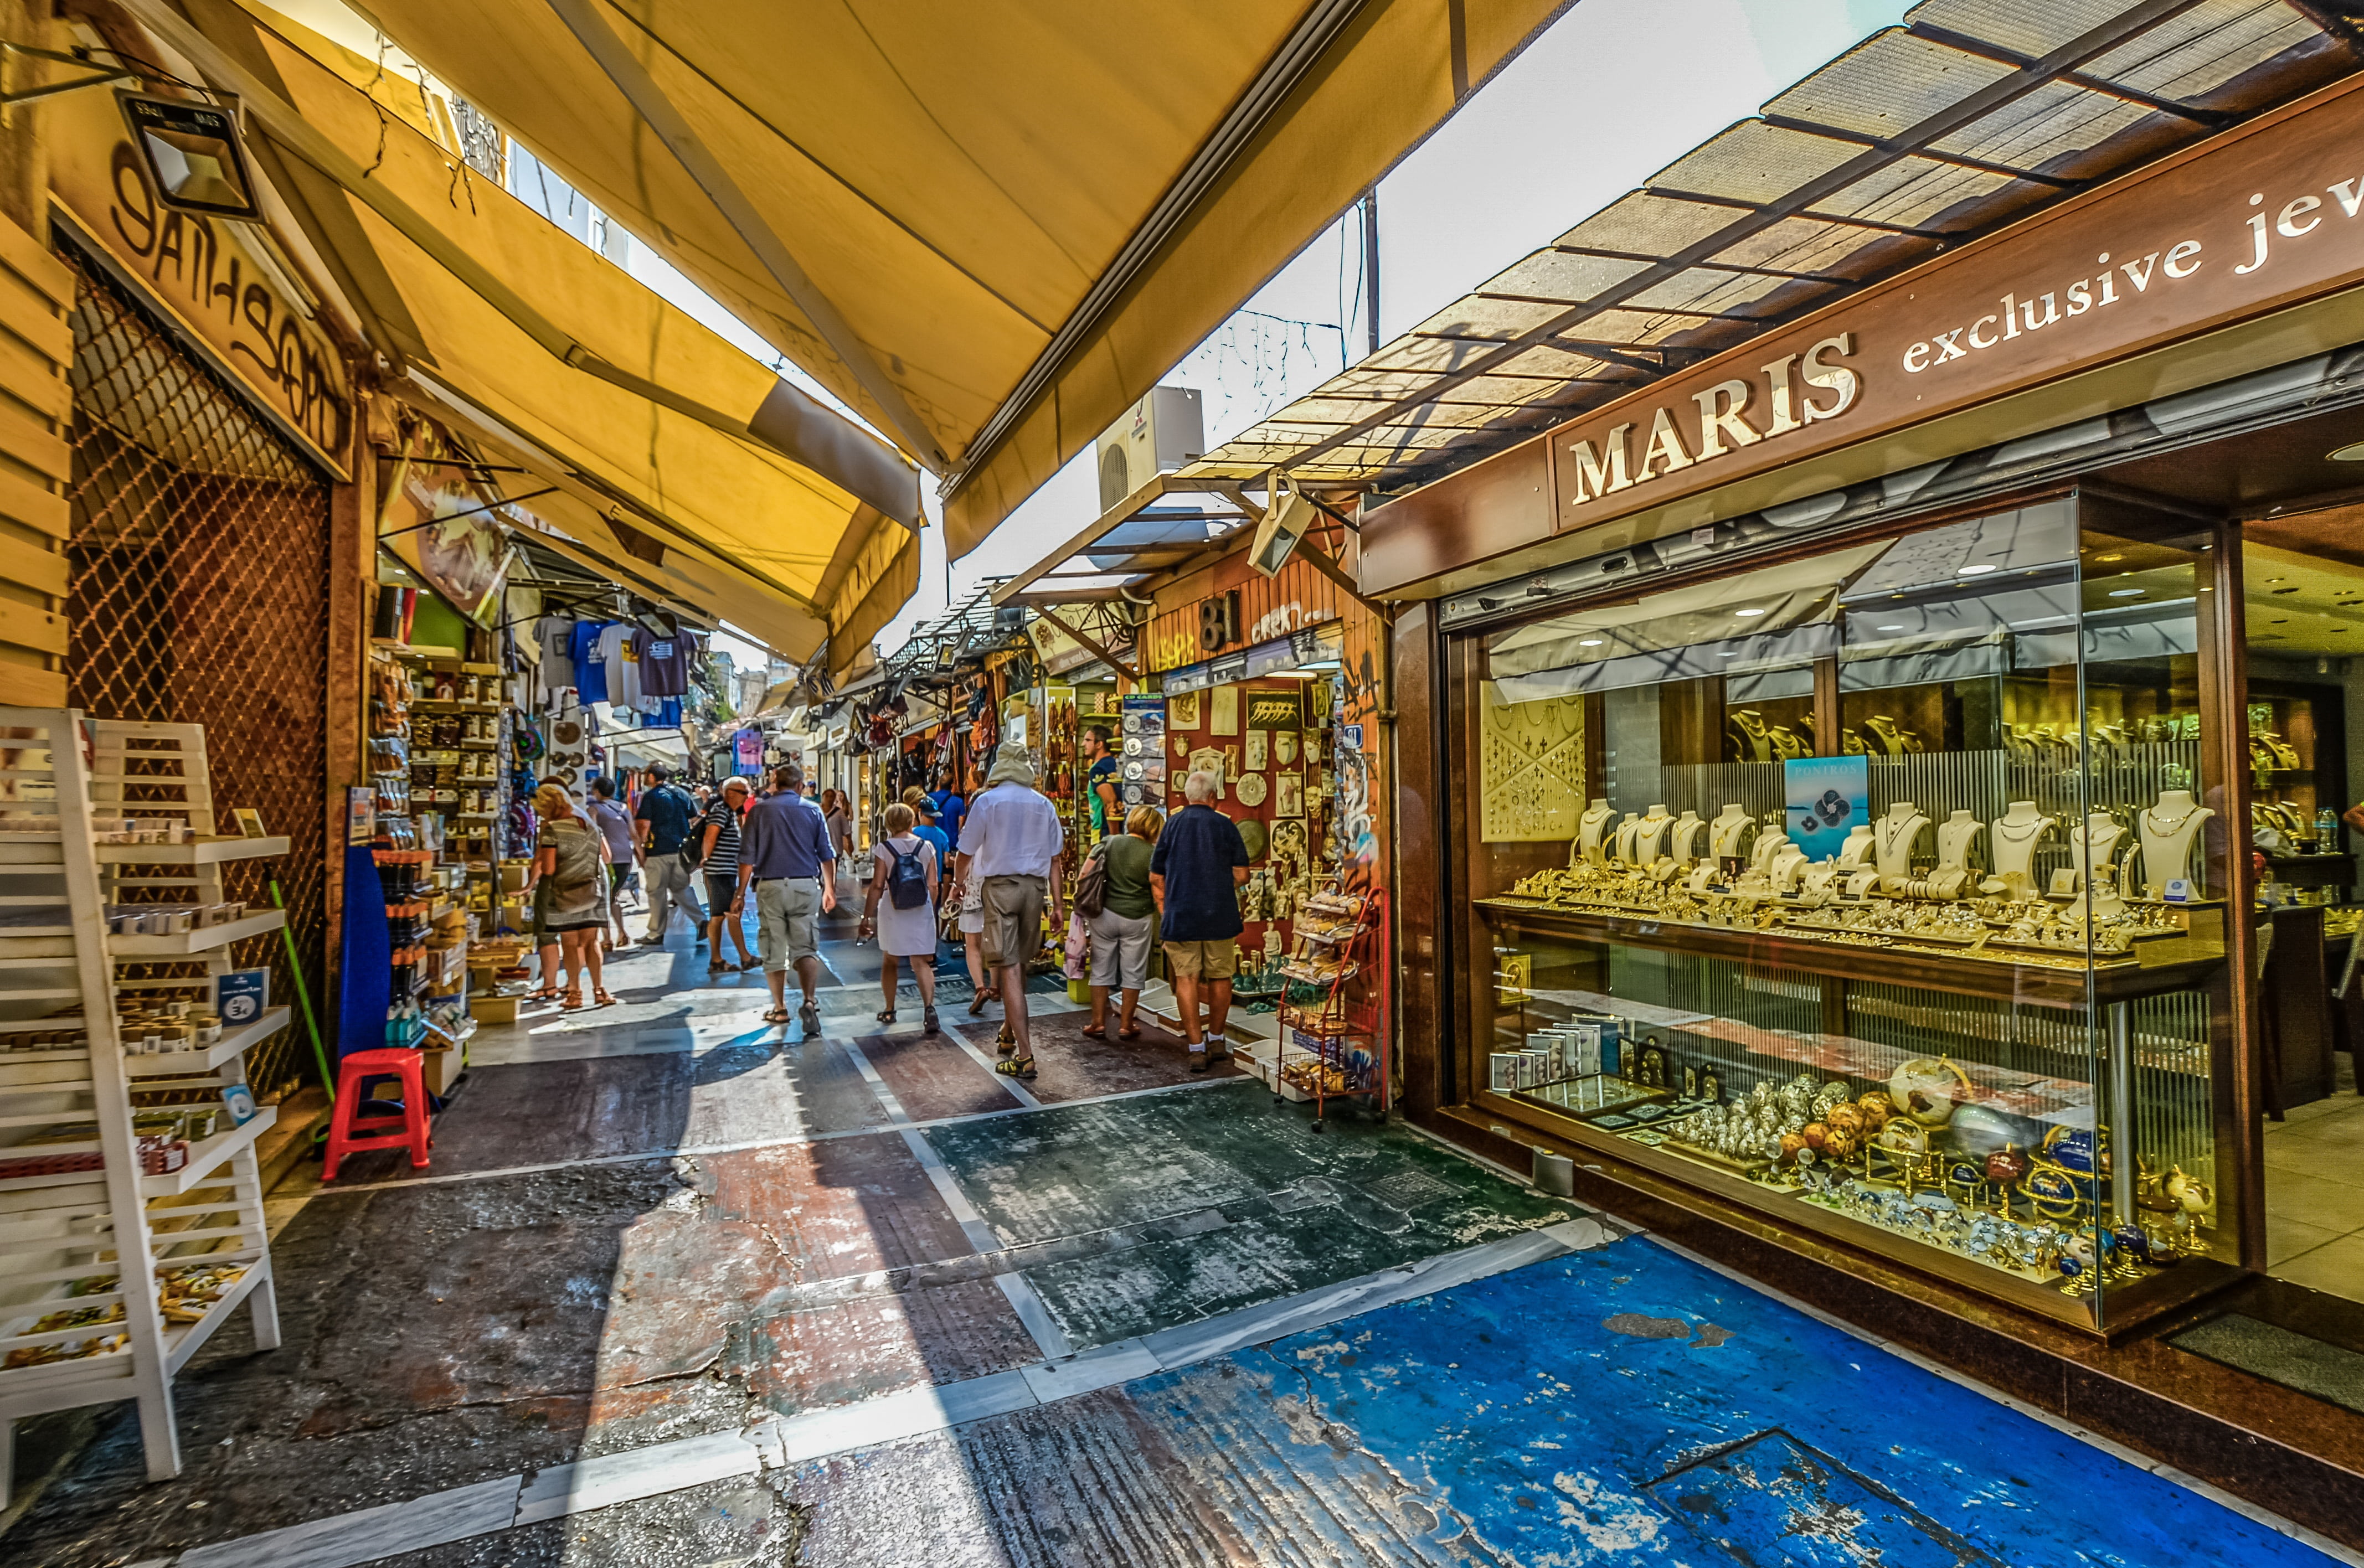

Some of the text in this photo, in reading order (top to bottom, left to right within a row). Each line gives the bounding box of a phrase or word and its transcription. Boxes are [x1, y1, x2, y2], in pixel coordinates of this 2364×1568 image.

[1569, 332, 1858, 506] MARIS
[1902, 240, 2203, 374] exclusive
[1199, 589, 1240, 652] 81
[1795, 765, 1857, 776] PONIROS
